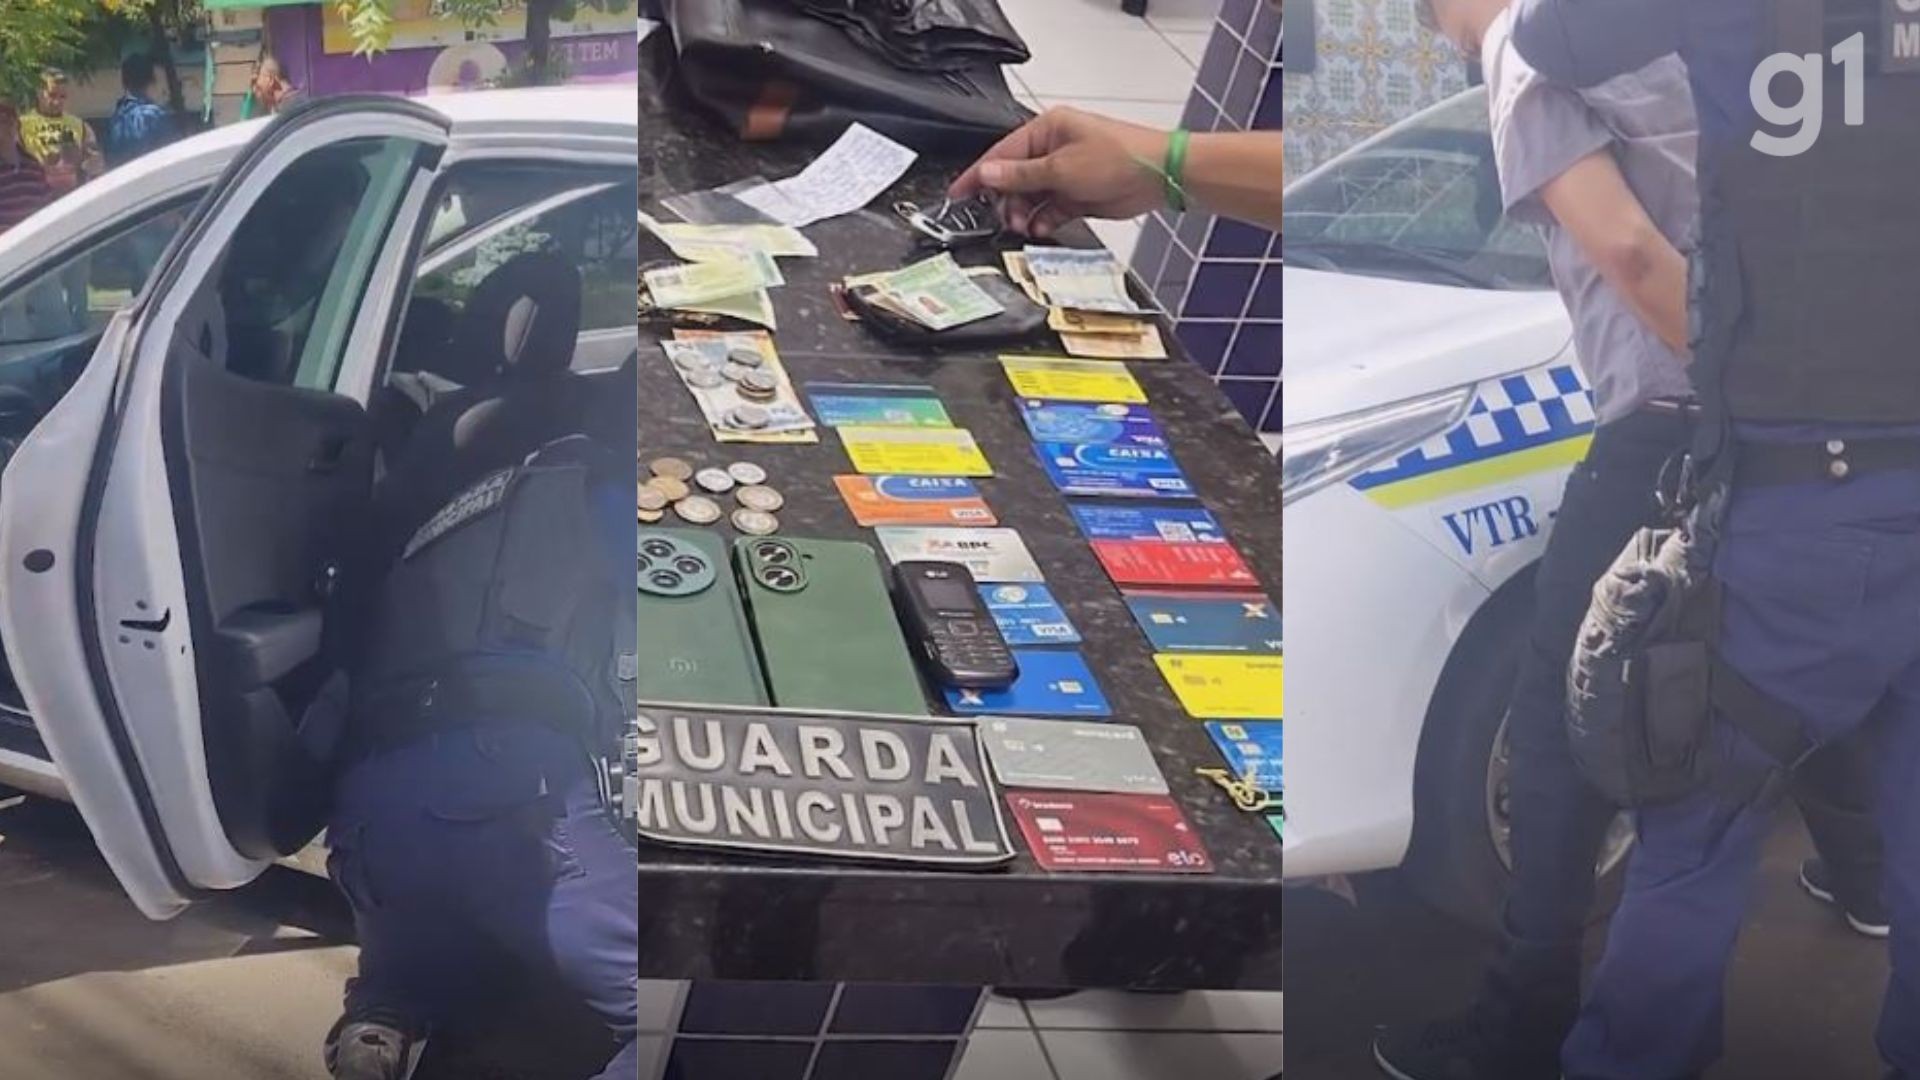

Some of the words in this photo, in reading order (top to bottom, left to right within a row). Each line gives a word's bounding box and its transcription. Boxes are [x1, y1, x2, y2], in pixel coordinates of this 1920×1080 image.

[579, 41, 620, 62] TEM
[1108, 449, 1168, 459] CAIXA
[908, 477, 967, 488] CAIXA
[1441, 496, 1539, 555] VTR
[1037, 626, 1069, 635] VISA
[1166, 850, 1206, 866] elo
